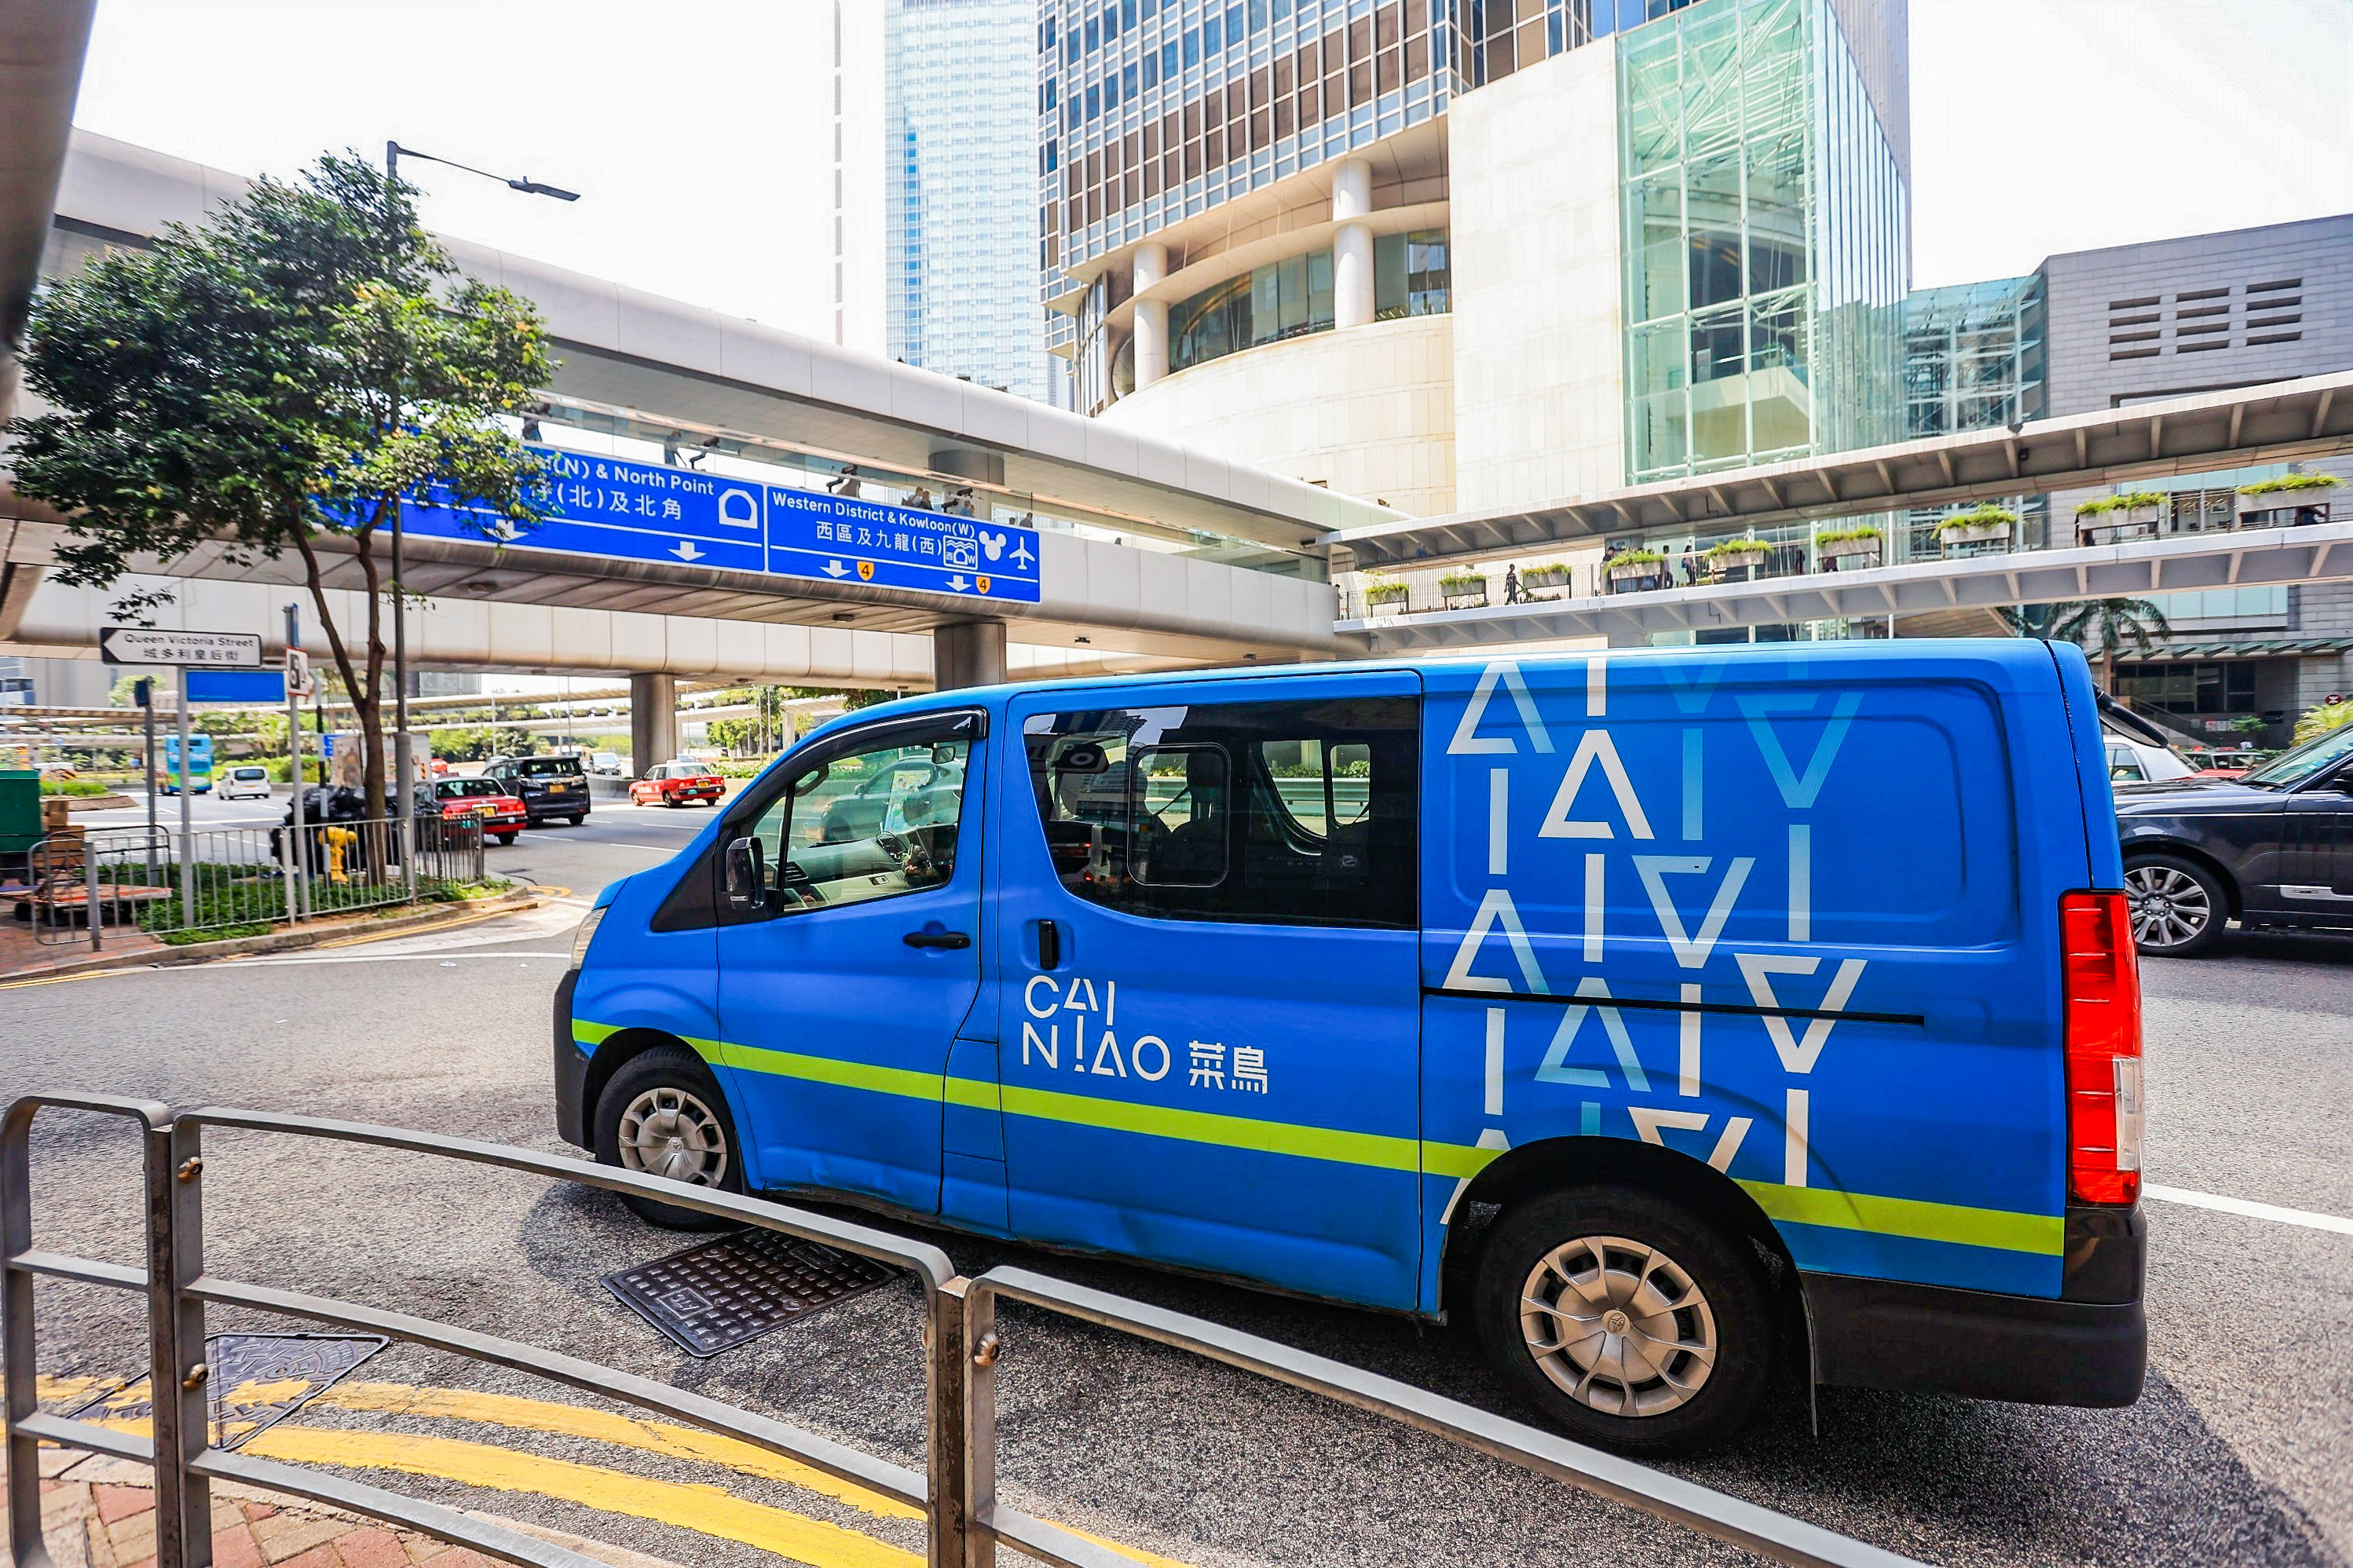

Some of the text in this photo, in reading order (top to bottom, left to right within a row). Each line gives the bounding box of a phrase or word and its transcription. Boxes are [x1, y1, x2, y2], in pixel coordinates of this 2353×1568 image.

[595, 462, 609, 480] &
[614, 466, 666, 488] North
[670, 474, 715, 495] Point
[772, 491, 975, 539] Western District & Kowloon(W)
[815, 521, 942, 556] 西區及九龍(西)
[862, 564, 870, 576] 4
[967, 554, 975, 565] W
[979, 579, 986, 590] 4
[124, 634, 254, 647] Queen Victoria Street
[1024, 974, 1115, 1026] CAI
[1188, 1040, 1268, 1095] 菜鳥
